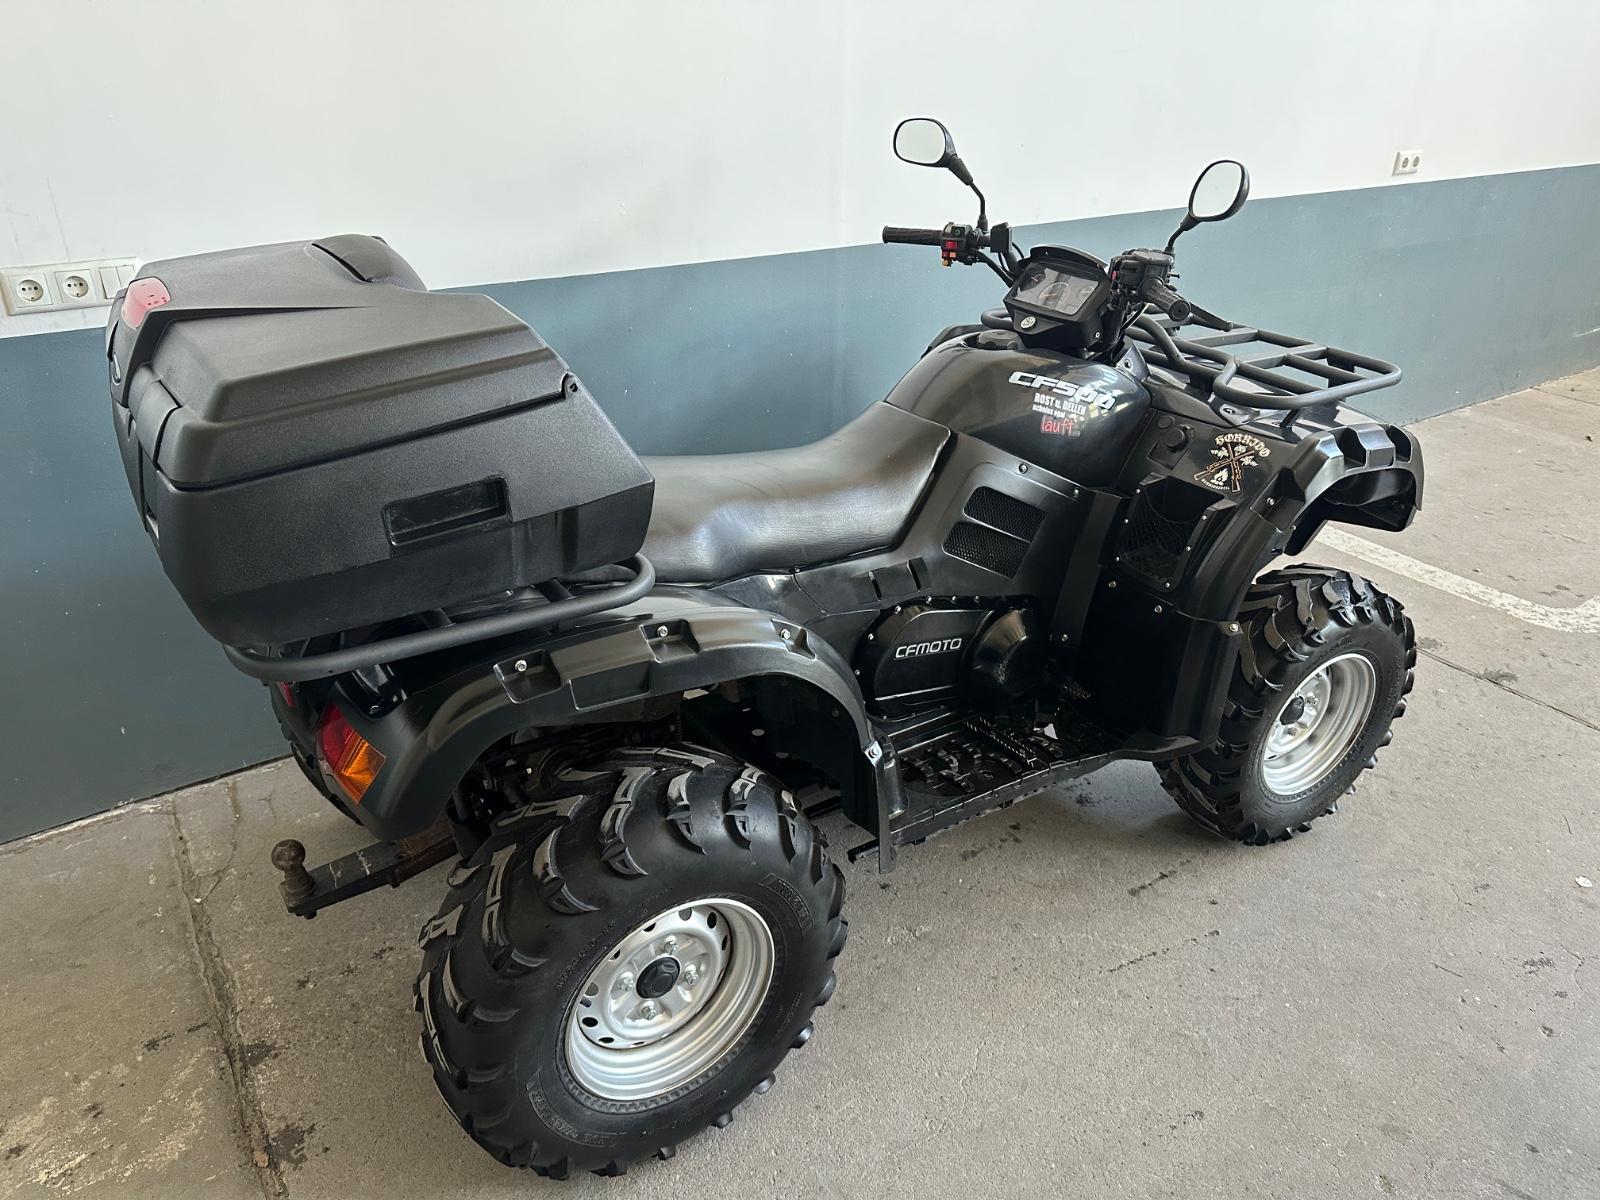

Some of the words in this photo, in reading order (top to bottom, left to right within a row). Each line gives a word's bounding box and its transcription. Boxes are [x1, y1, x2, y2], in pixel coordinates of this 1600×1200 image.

[1009, 371, 1116, 410] CF500
[1034, 392, 1054, 406] ROST
[1215, 433, 1271, 458] HORRIDO
[895, 638, 962, 659] CFMOTO
